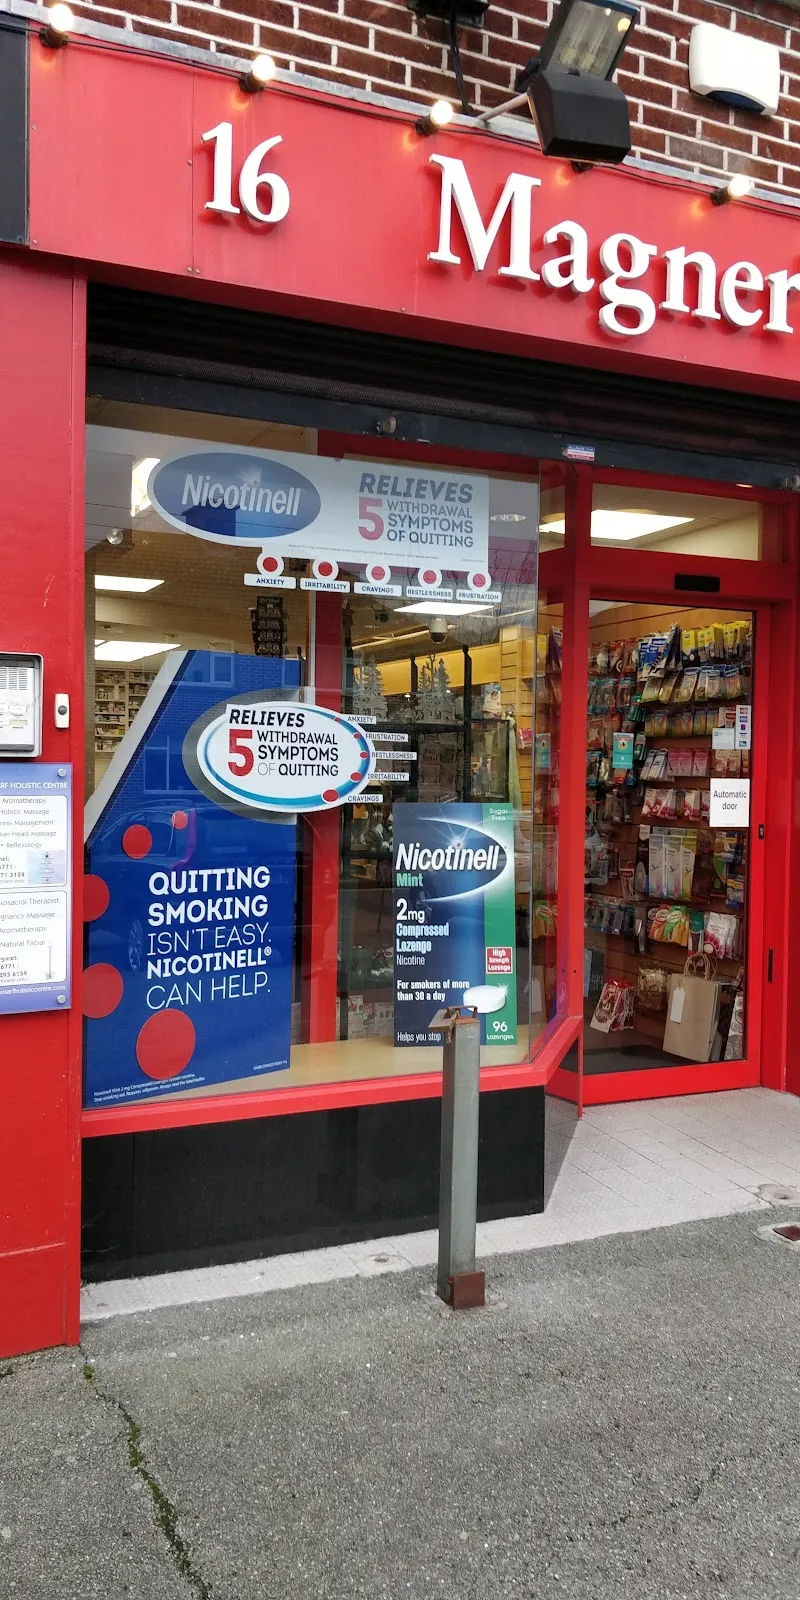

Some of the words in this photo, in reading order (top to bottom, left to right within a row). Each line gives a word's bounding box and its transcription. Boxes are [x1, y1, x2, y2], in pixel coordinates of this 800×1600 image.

[201, 121, 290, 224] 16
[358, 472, 473, 504] RELIEVES
[182, 473, 301, 516] Nicotinell
[386, 499, 473, 519] WITHDRAWAL
[358, 496, 384, 541] 5
[387, 512, 473, 534] SYMPTOMS
[387, 529, 406, 542] OF
[408, 531, 474, 548] QUITTING
[256, 577, 285, 586] ANXIETY
[304, 581, 347, 591] IRRITABILITY
[361, 585, 394, 594] CRAVINGS
[407, 589, 452, 598] RESTLESSNESS
[458, 592, 499, 600] FRUSTRATION
[229, 708, 305, 728] RELIEVES
[347, 715, 373, 723] ANXIETY
[256, 729, 338, 745] WITHDRAWAL
[365, 732, 406, 741] FRUSTRATION
[227, 728, 254, 777] 5
[258, 744, 339, 762] SYMPTOMS
[371, 751, 414, 759] RESTLESSNESS
[257, 762, 276, 776] OF
[278, 763, 339, 777] QUITTING
[713, 790, 747, 799] Automatic
[24, 808, 50, 816] Massage
[489, 808, 509, 816] Sugar
[722, 802, 738, 810] door
[14, 819, 54, 827] Management
[395, 842, 500, 871] Nicotinell
[148, 866, 271, 896] QUITTING
[396, 873, 423, 887] Mint
[29, 897, 60, 905] Therapist
[27, 912, 56, 920] Massage
[148, 894, 269, 927] SMOKING
[396, 922, 449, 938] Compressed
[147, 928, 209, 956] ISN'T
[214, 922, 272, 949] EASY.
[396, 938, 432, 954] Lozenge
[492, 948, 506, 958] High
[396, 954, 426, 966] Nicotine
[146, 979, 202, 1010] CAN
[211, 971, 271, 1001] HELP.
[397, 980, 409, 989] For
[411, 979, 441, 990] smokers
[443, 979, 451, 989] of
[452, 981, 470, 989] more
[397, 992, 413, 1001] than
[415, 992, 425, 1001] 30
[433, 991, 446, 1002] day
[493, 1021, 508, 1032] 96
[397, 1032, 414, 1043] Helps
[415, 1034, 427, 1043] you
[428, 1032, 442, 1042] stop
